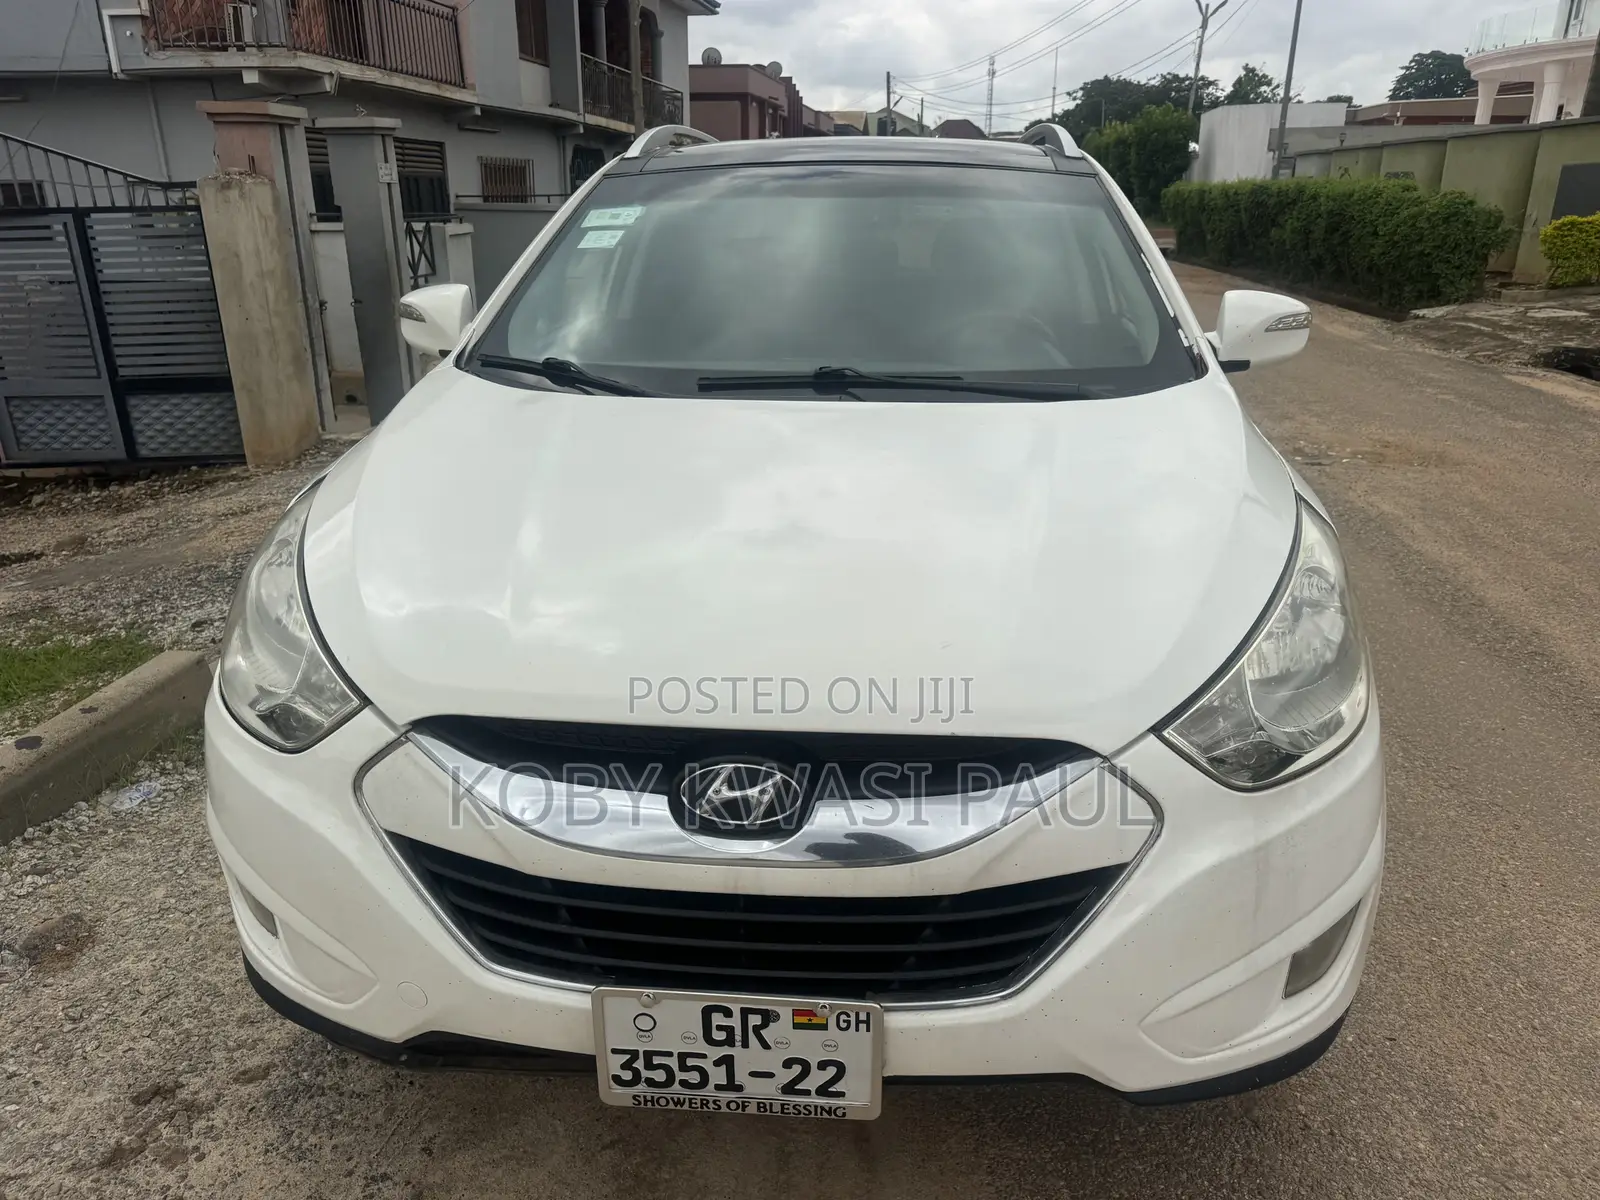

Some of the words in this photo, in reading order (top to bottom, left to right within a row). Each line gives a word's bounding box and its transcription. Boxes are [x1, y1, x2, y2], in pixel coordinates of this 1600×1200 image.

[701, 1004, 772, 1050] GR
[836, 1011, 871, 1033] GH
[610, 1048, 846, 1098] 3551-22
[632, 1094, 722, 1111] SHOWERS
[726, 1100, 752, 1112] OF
[756, 1101, 847, 1118] BLESSING
